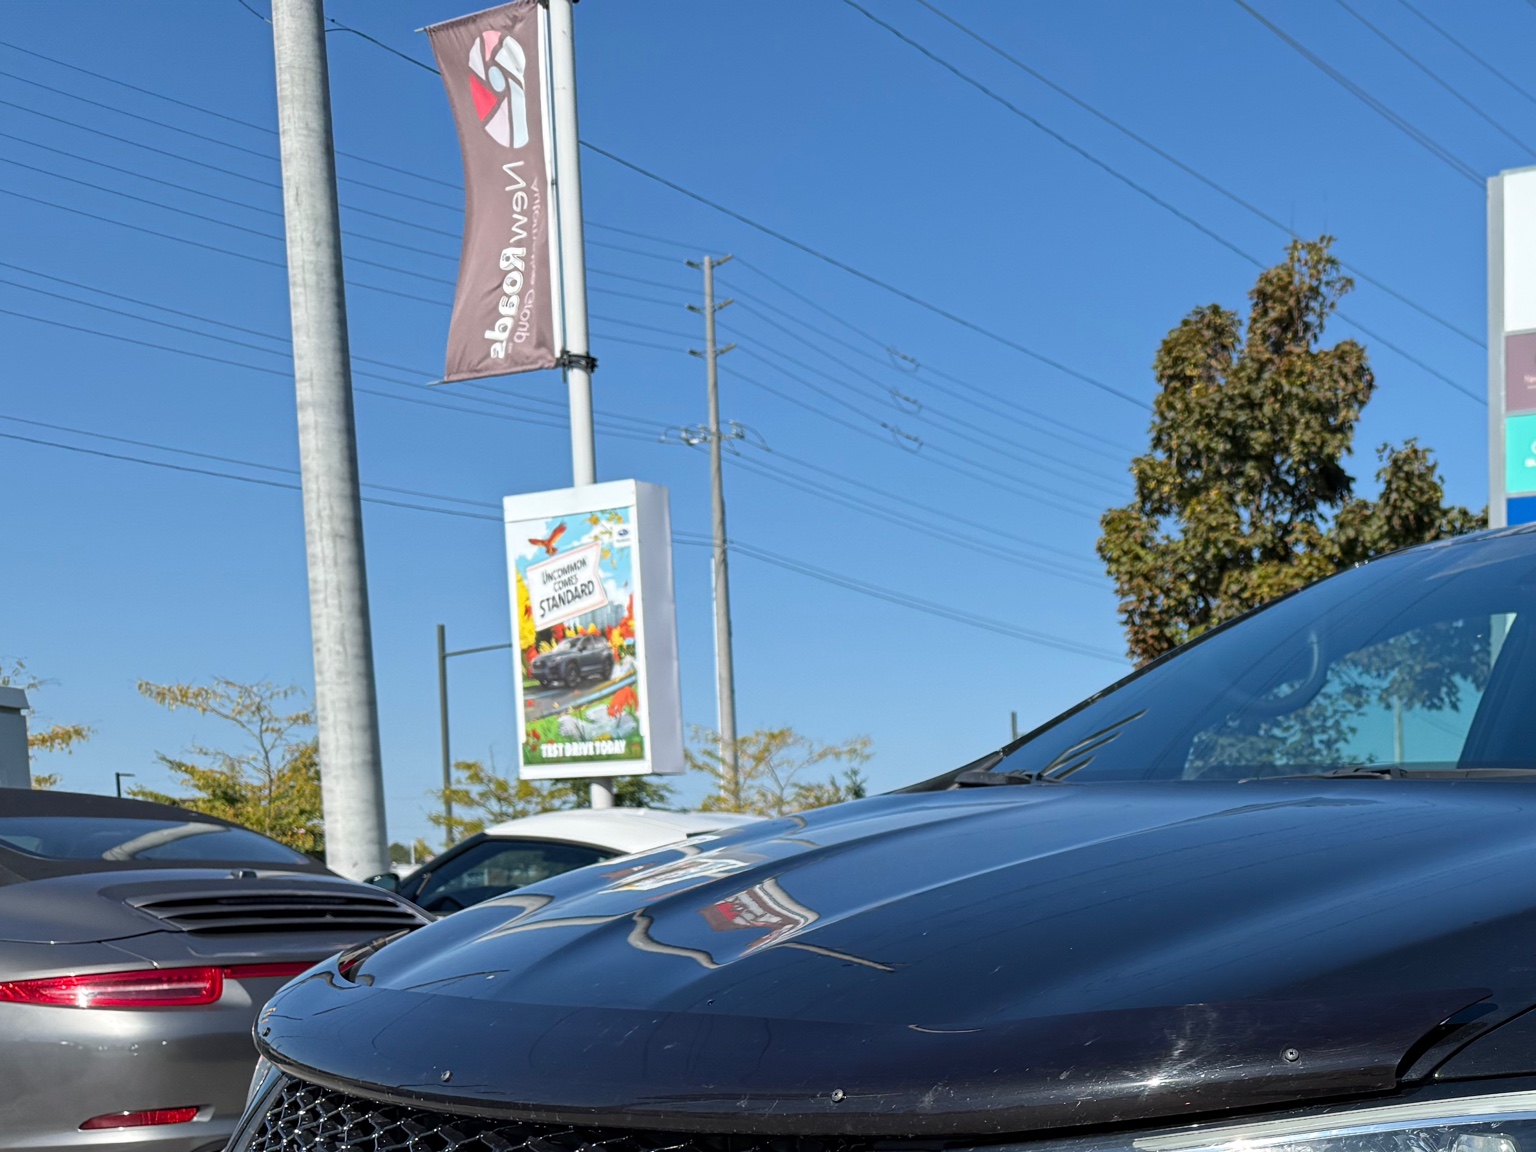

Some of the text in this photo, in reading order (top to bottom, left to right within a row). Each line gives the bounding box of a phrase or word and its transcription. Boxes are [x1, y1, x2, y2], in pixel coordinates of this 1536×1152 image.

[539, 580, 595, 618] STANDARD
[541, 739, 626, 758] TEST DRIVE TODAY
